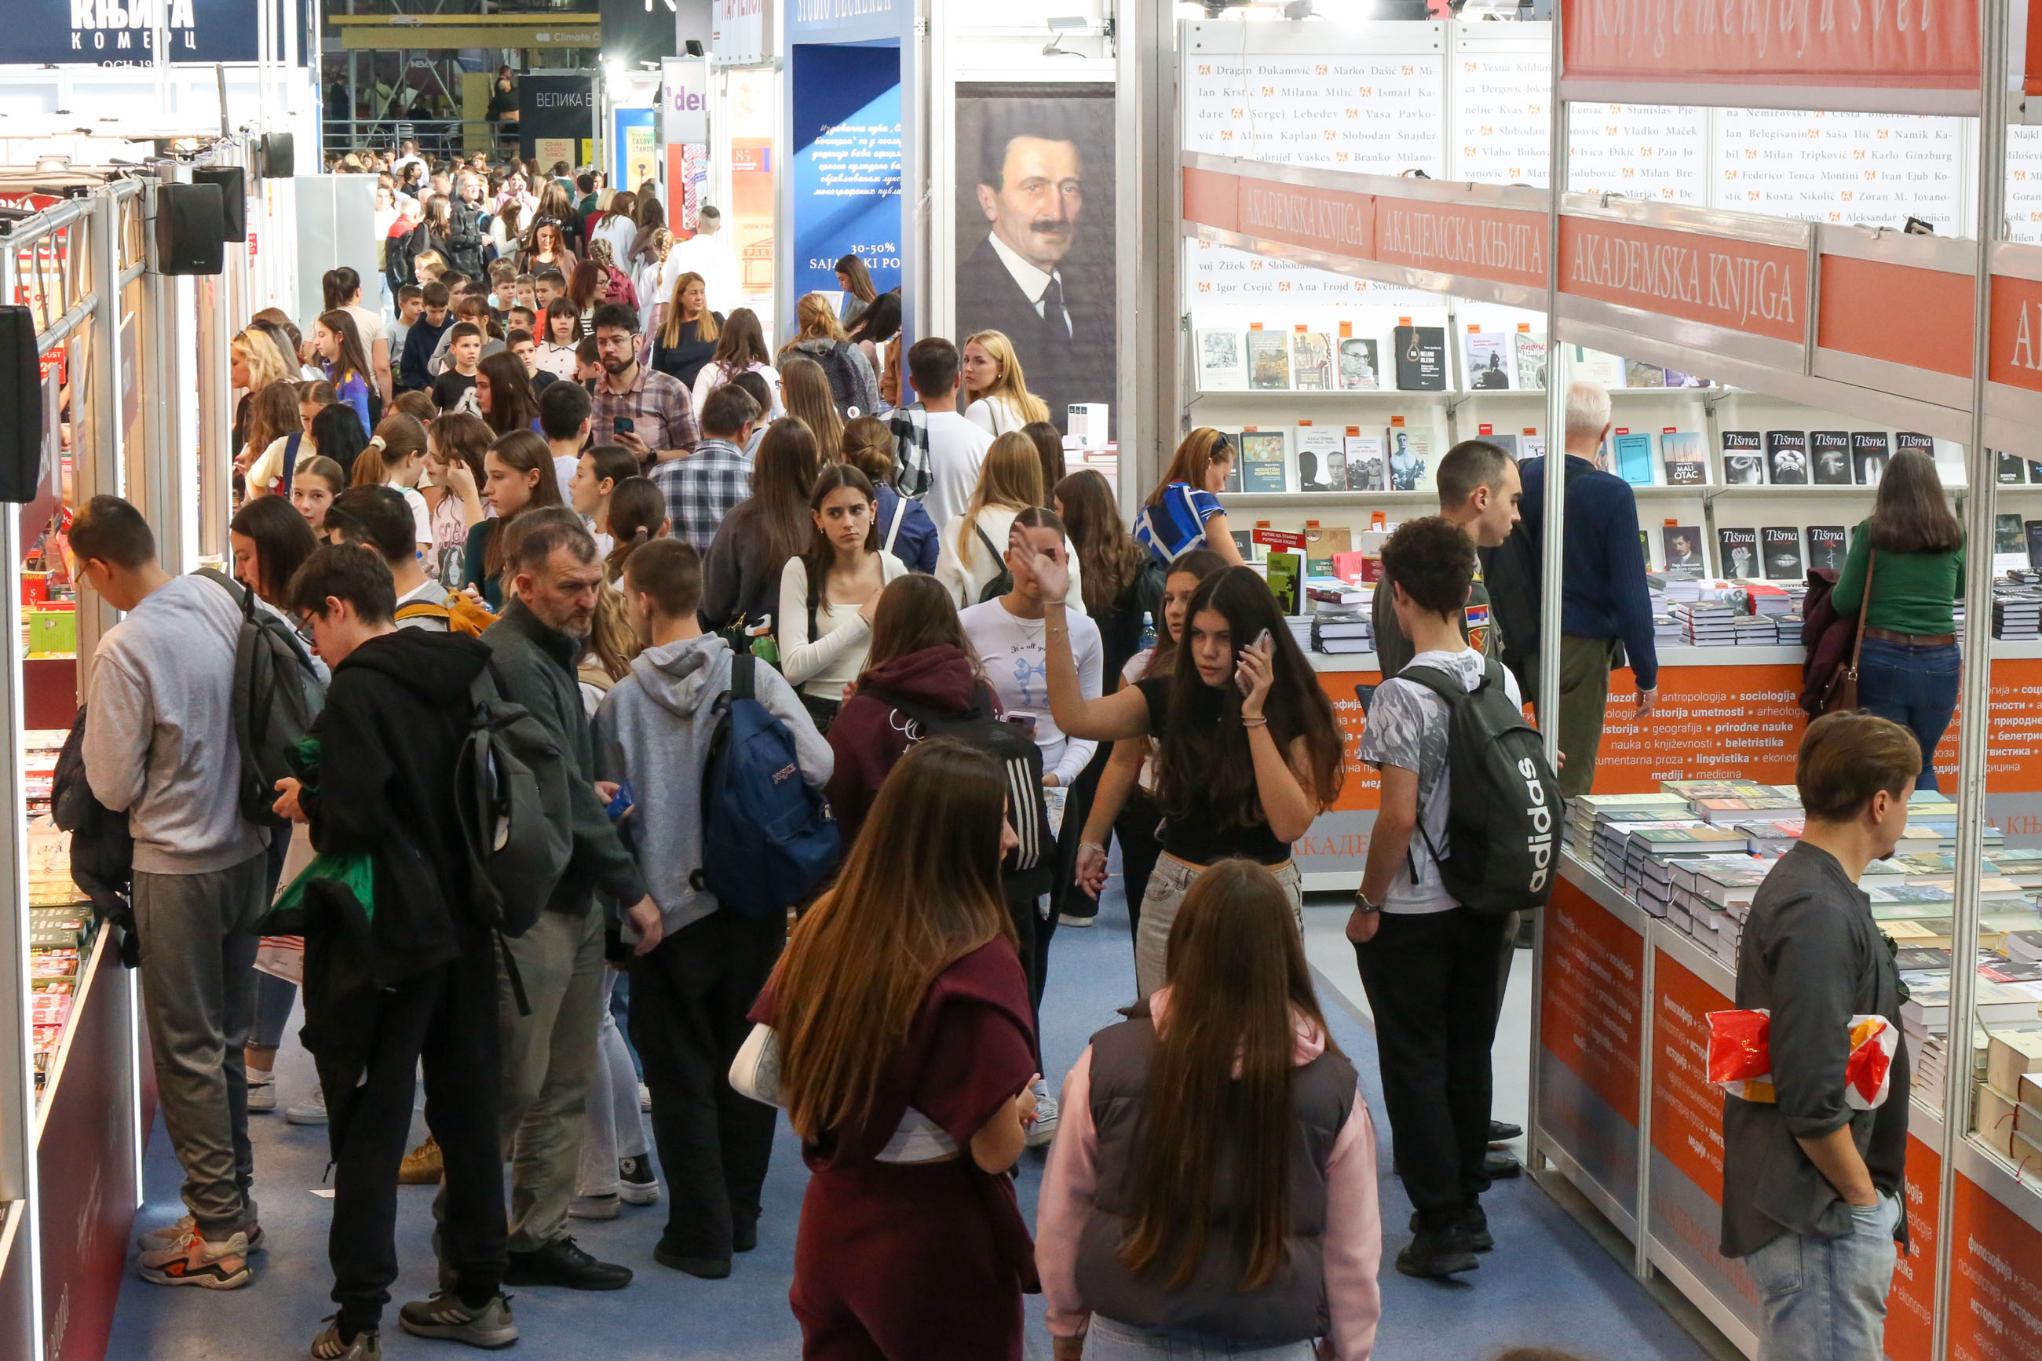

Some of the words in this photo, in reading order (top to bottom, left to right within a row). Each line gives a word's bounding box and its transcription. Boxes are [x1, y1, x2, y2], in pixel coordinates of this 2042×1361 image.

[553, 33, 590, 42] Climate
[1334, 66, 1365, 76] Marko
[1281, 88, 1318, 96] Milana
[536, 93, 582, 108] ВЕЛИКА
[1199, 109, 1224, 118] dare
[1366, 110, 1391, 118] Vasa
[1280, 132, 1318, 142] Kaplan
[1343, 130, 1390, 140] Slobodan
[1499, 126, 1544, 135] Slobodan
[1624, 126, 1659, 135] Vladko
[1896, 130, 1928, 139] Namik
[2014, 130, 2039, 141] Majkl
[1354, 153, 1390, 162] Branko
[1763, 151, 1793, 159] Milan
[1872, 151, 1899, 160] Karlo
[1906, 152, 1952, 162] Ginzburg
[1743, 171, 1782, 180] Federico
[1820, 171, 1859, 180] Montini
[1882, 172, 1902, 180] Ivan
[1766, 192, 1793, 200] Kosta
[2013, 192, 2041, 200] Goran
[1246, 190, 1316, 236] AKADEMSKA
[1316, 199, 1364, 247] KNJIGA
[1846, 212, 1896, 222] Aleksandar
[1384, 208, 1478, 265] АКАДЕМСКА
[1480, 219, 1543, 274] КЊИГА
[850, 242, 896, 256] 30-50%
[1572, 232, 1701, 305] AKADEMSKA
[1707, 252, 1795, 326] KNJIGA
[1217, 283, 1236, 294] Igor
[1298, 284, 1317, 292] Ana
[1324, 282, 1349, 294] Frojd
[1726, 433, 1758, 447] Tišma
[1772, 432, 1804, 446] Tišma
[1815, 433, 1847, 447] Tišma
[1855, 434, 1886, 448] Tišma
[1900, 434, 1932, 448] Tišma
[1676, 464, 1694, 472] MALI
[1674, 471, 1698, 480] OTAC
[1724, 530, 1755, 543] Tišma
[1766, 529, 1798, 542] Tišma
[1812, 529, 1844, 542] Tišma
[1662, 693, 1727, 704] antropologija
[1740, 692, 1796, 703] sociologija
[1652, 708, 1688, 719] istorija
[1692, 707, 1744, 718] umetnosti
[1602, 724, 1639, 736] istorija
[1652, 724, 1702, 736] geografija
[1715, 722, 1760, 734] prirodne
[1762, 722, 1793, 732] nauke
[1611, 740, 1641, 750] nauka
[1654, 739, 1712, 752] književnosti
[1725, 738, 1784, 748] beletristika
[1655, 756, 1684, 766] proza
[1696, 754, 1750, 764] lingvistika
[1652, 770, 1684, 782] mediji
[1696, 770, 1742, 780] medicina
[1518, 757, 1552, 893] adidas
